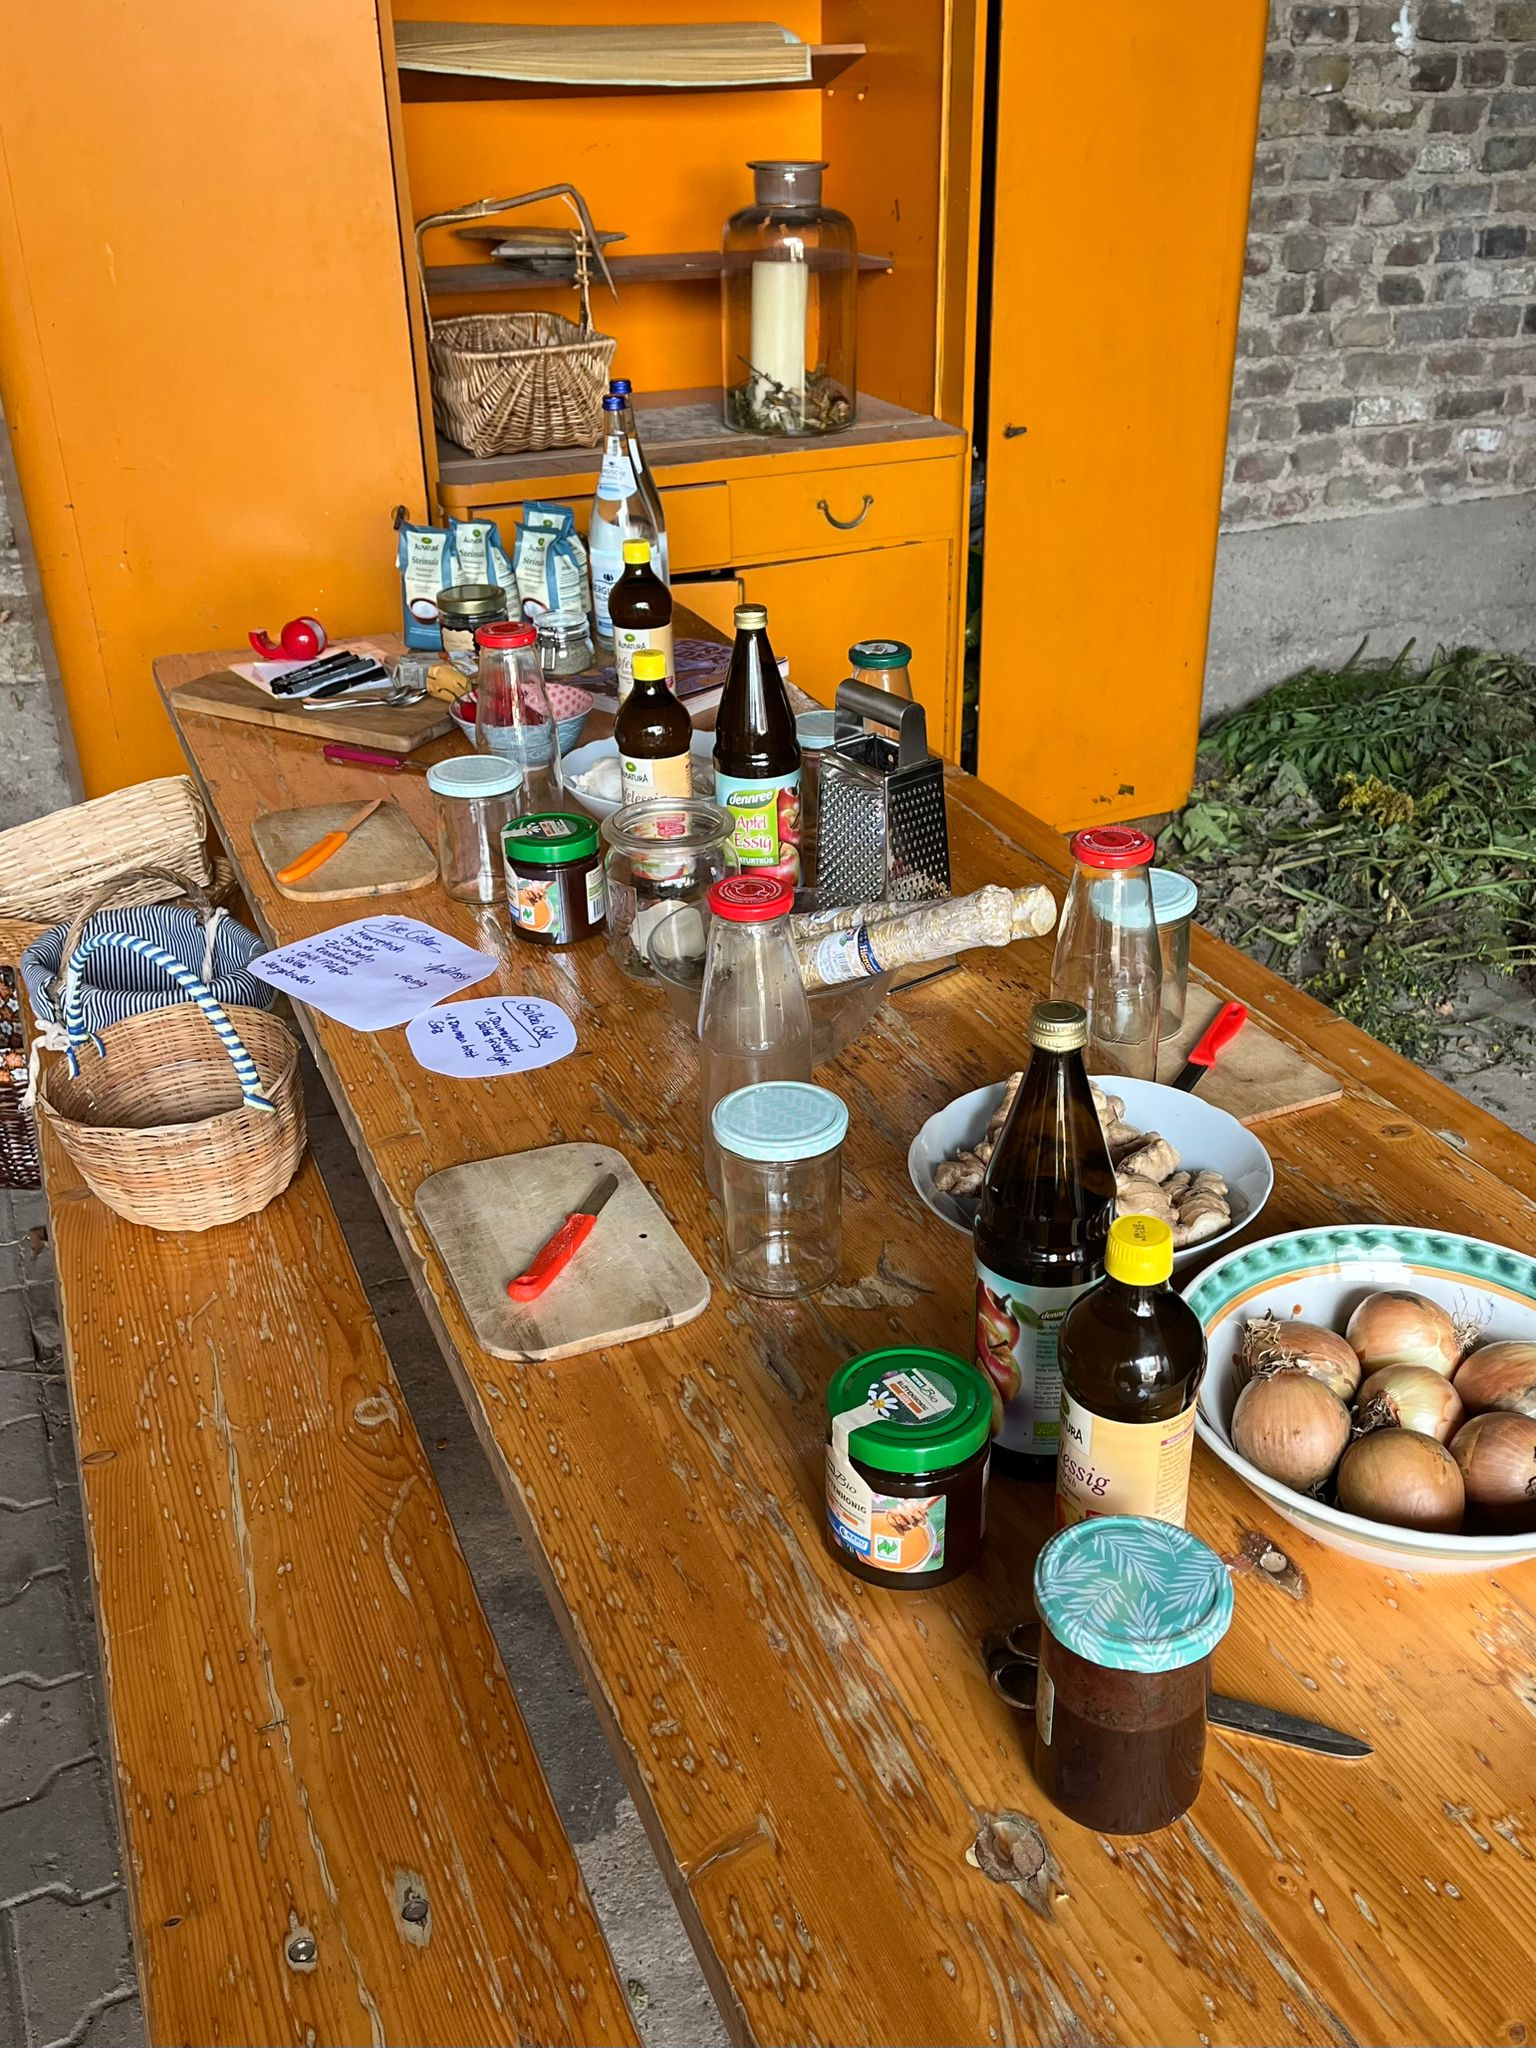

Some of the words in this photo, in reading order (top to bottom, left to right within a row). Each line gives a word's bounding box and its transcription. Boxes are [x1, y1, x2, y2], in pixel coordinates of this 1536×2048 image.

[728, 790, 774, 805] dennree
[736, 815, 767, 832] Apfel
[734, 832, 772, 851] Essig
[381, 921, 410, 934] Fire
[405, 930, 441, 946] Cider
[341, 935, 379, 951] Ingwer
[475, 1020, 495, 1037] Salbei
[517, 1003, 545, 1026] Salbei
[532, 1025, 559, 1040] Sole
[920, 1387, 938, 1403] Bio
[835, 1471, 858, 1494] Bio
[830, 1481, 867, 1514] TENHONIG
